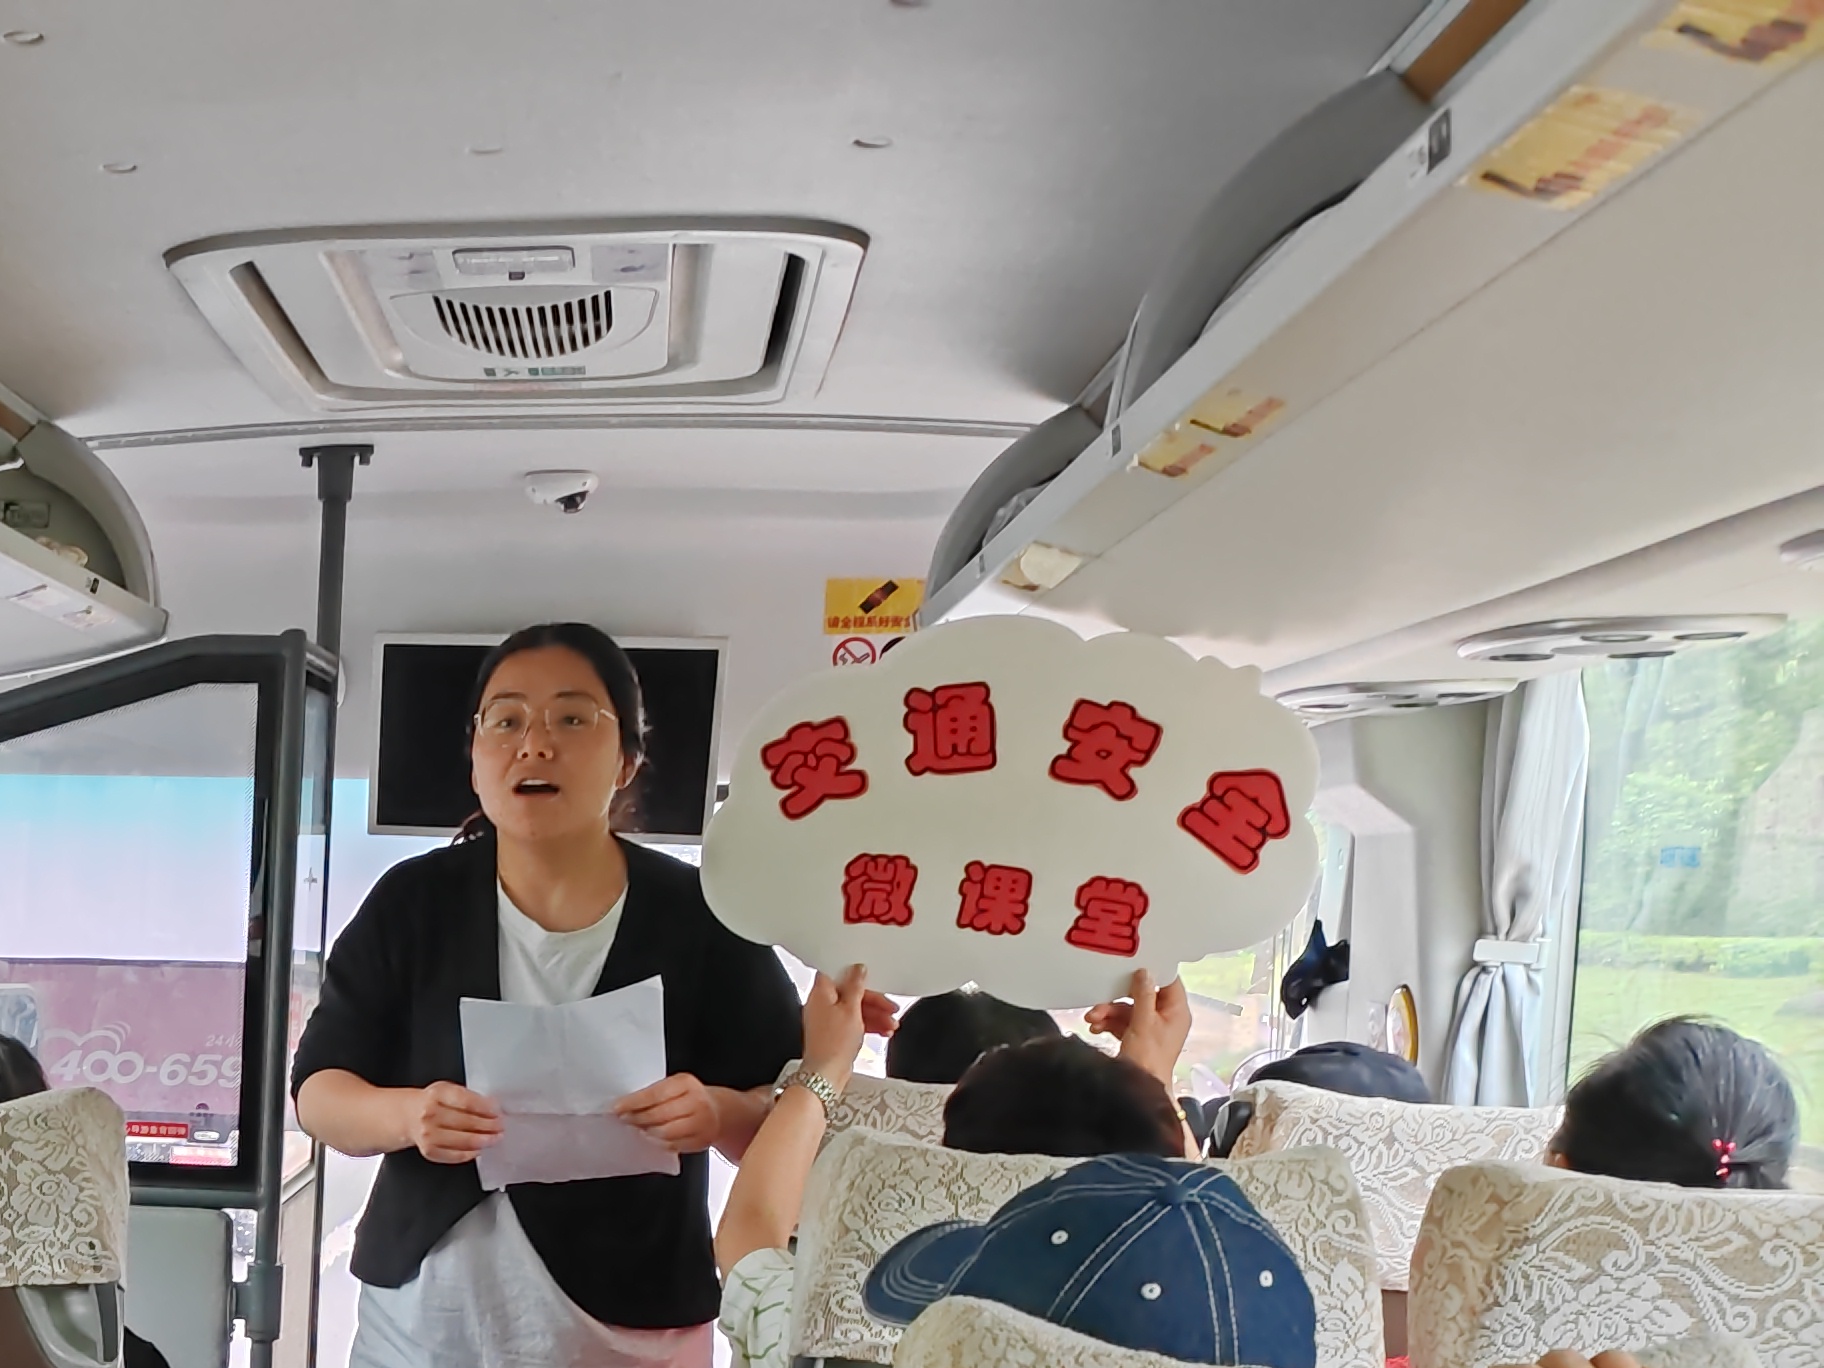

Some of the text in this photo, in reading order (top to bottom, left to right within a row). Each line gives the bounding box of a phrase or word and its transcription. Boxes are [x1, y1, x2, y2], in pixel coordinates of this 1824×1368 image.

[761, 682, 1291, 875] 交通安全
[841, 852, 1150, 958] 微课堂
